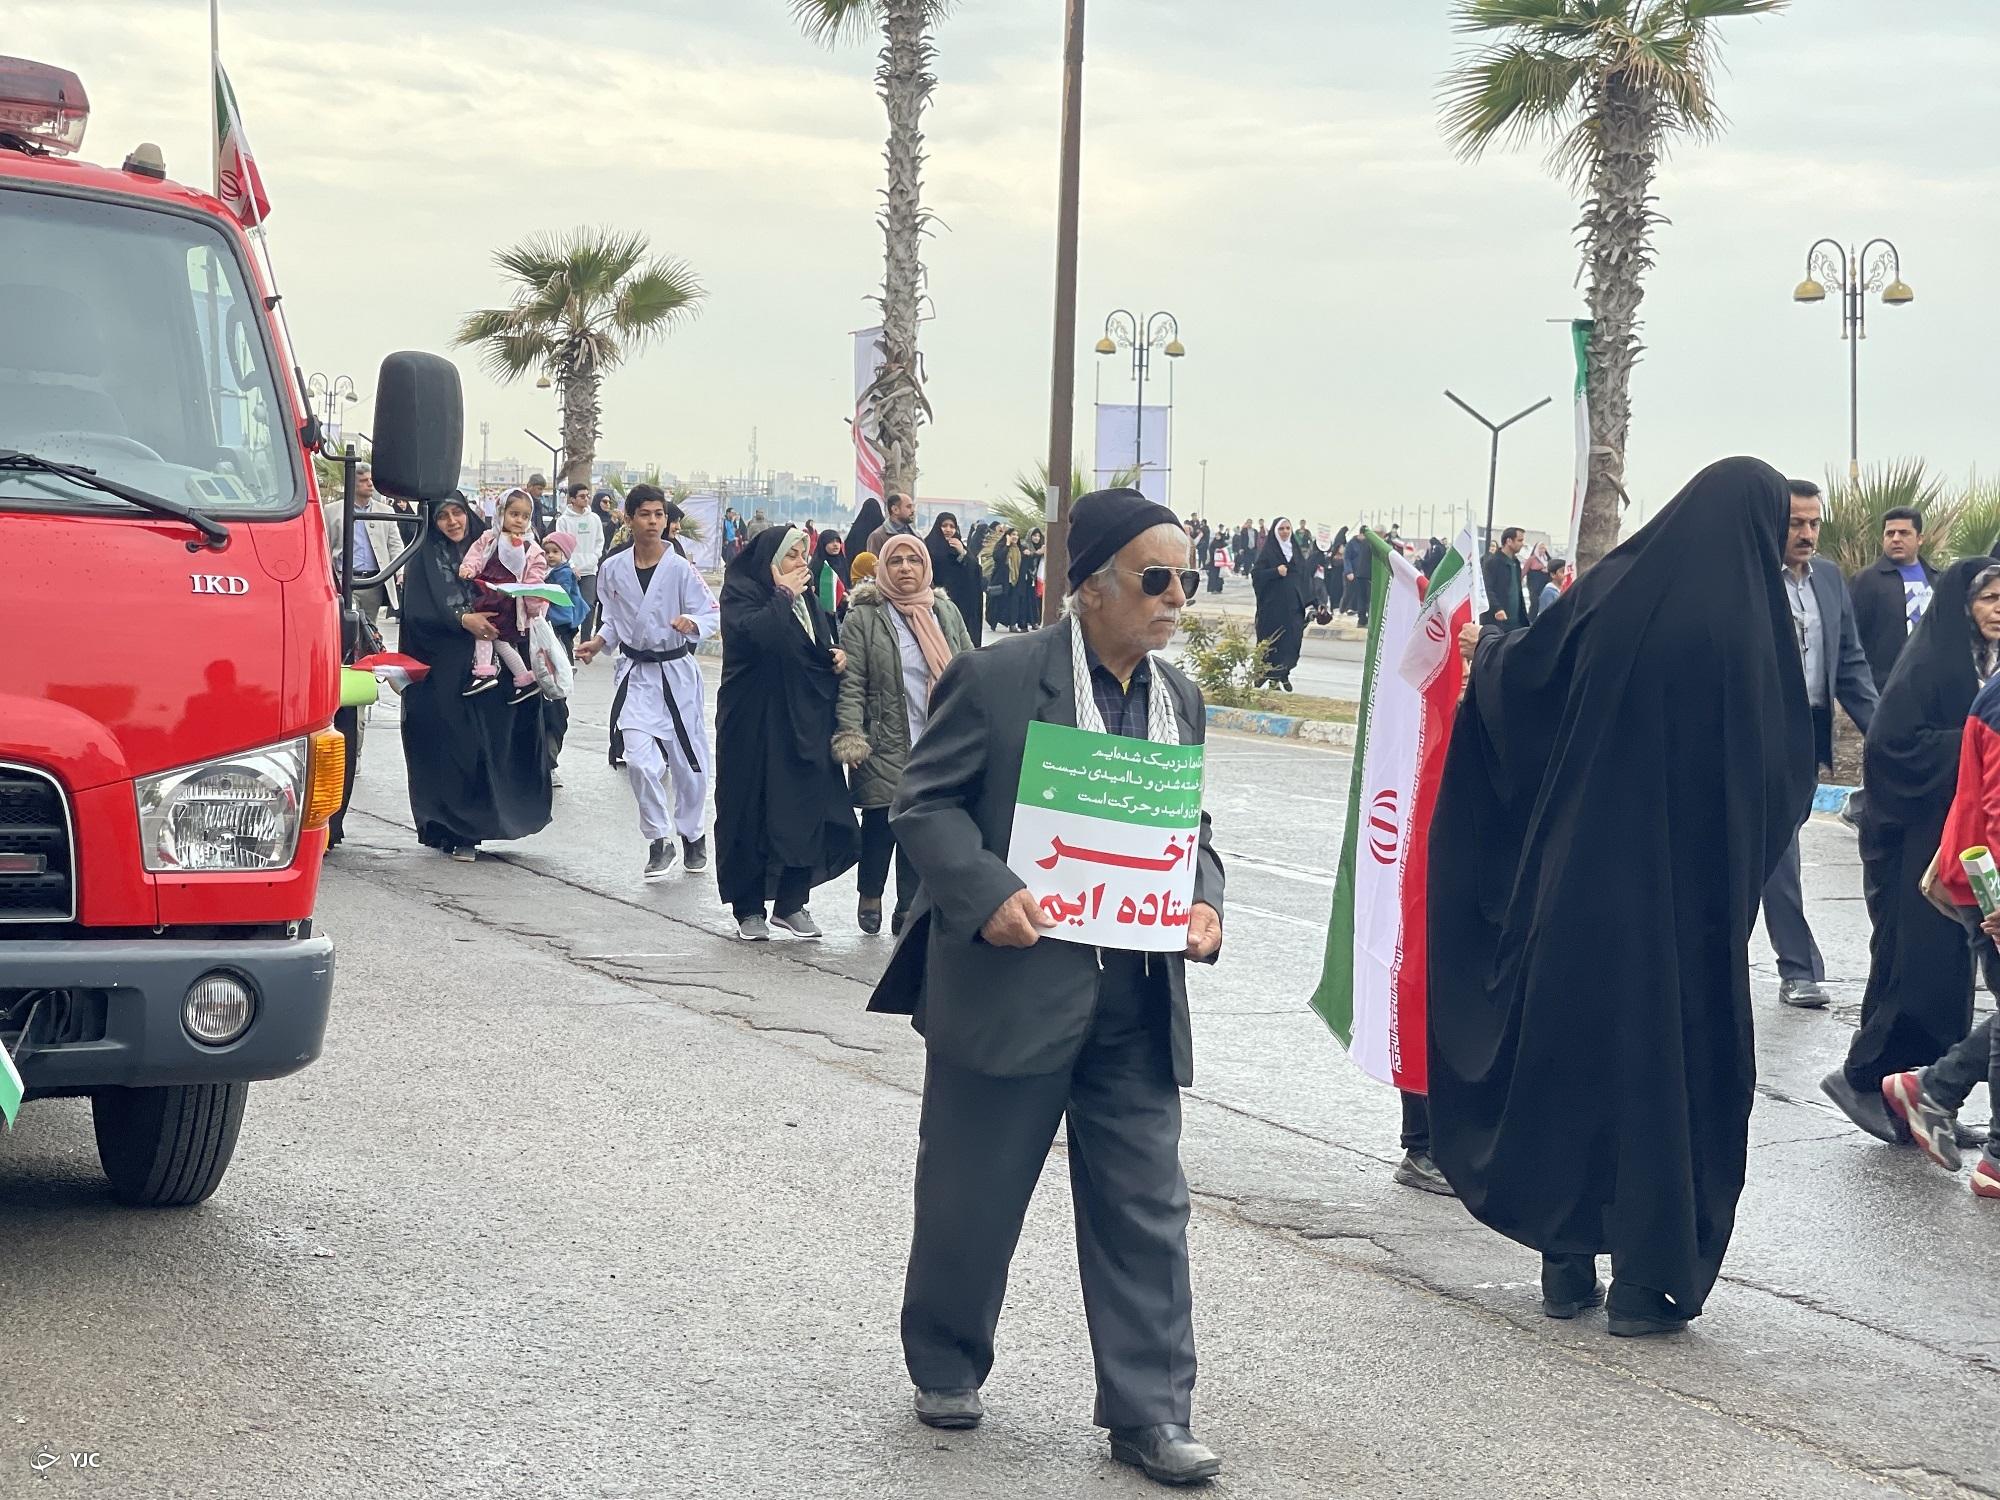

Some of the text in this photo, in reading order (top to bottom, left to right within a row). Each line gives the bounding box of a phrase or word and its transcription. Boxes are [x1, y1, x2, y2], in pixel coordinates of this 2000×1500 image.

[189, 574, 249, 595] IKD
[1042, 760, 1087, 777] نیست
[1142, 753, 1187, 772] نزدیک
[1088, 768, 1142, 784] ناامیدی
[1144, 779, 1153, 790] و
[1078, 792, 1106, 805] است
[1108, 796, 1151, 813] حرکت
[1151, 806, 1160, 816] و
[1034, 834, 1195, 872] آخر
[1040, 883, 1106, 927] ایم
